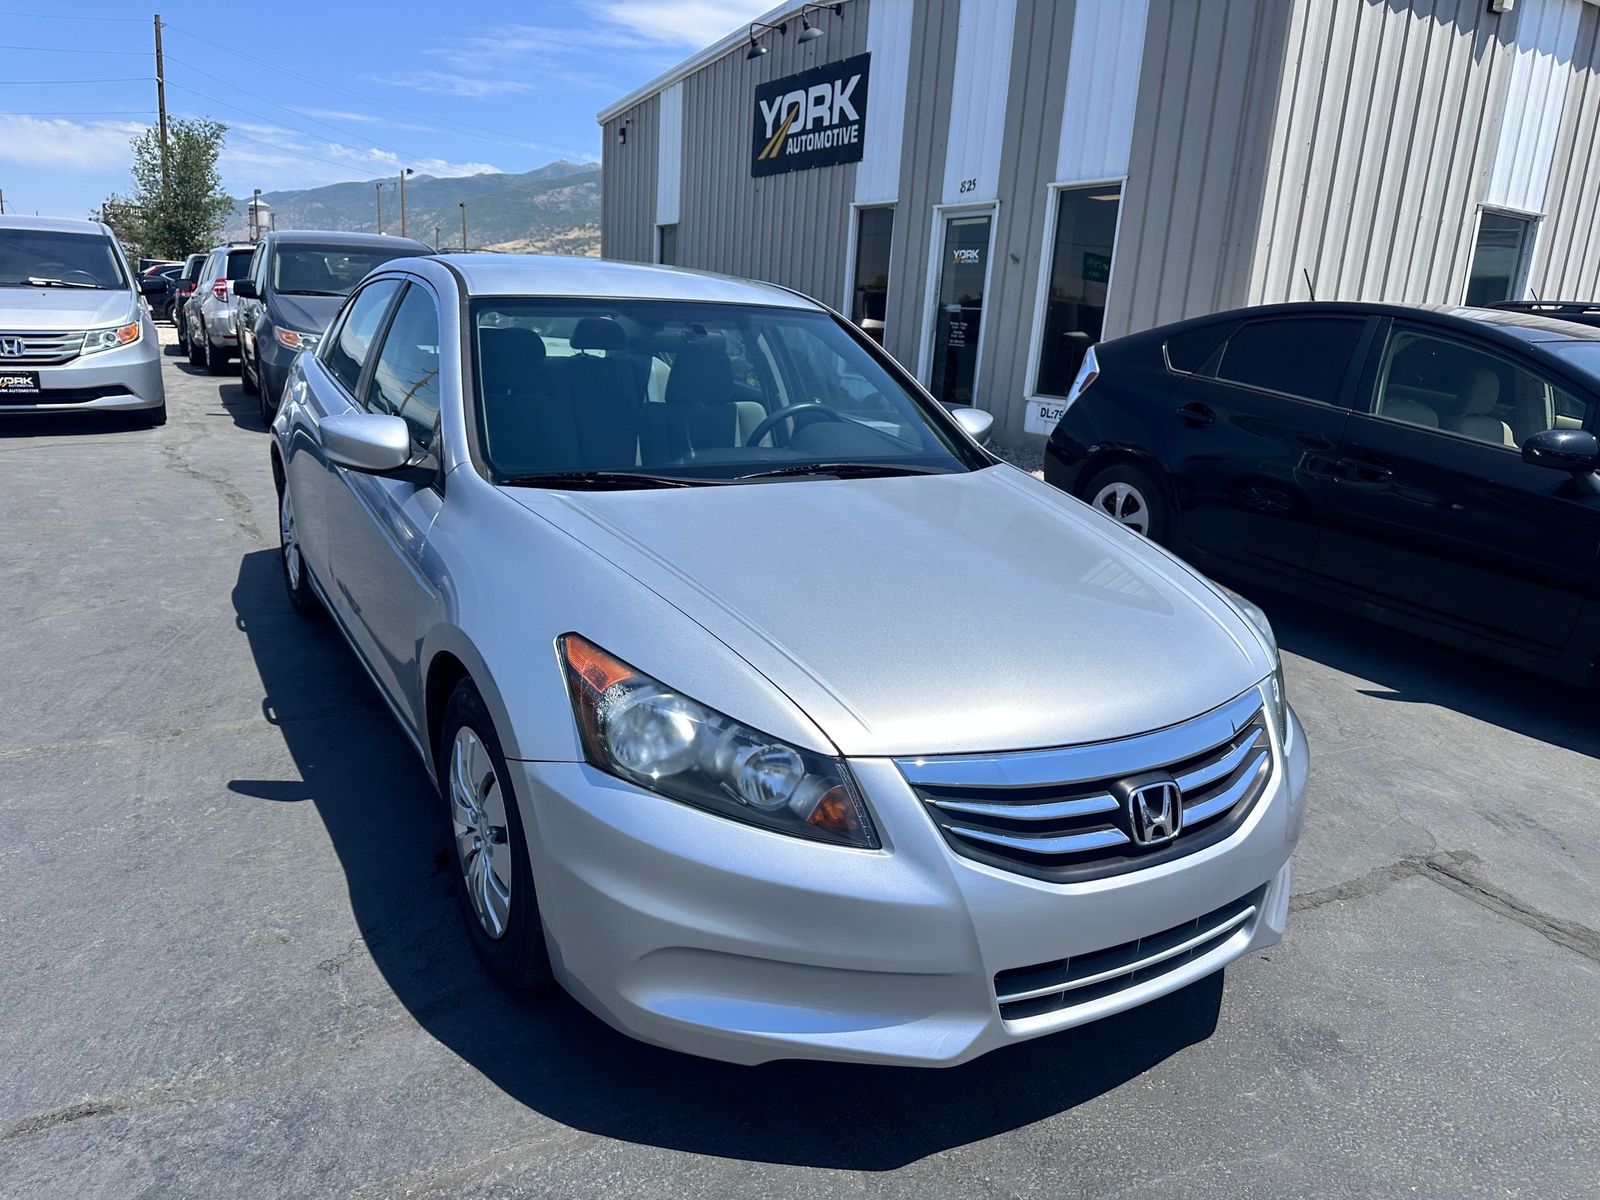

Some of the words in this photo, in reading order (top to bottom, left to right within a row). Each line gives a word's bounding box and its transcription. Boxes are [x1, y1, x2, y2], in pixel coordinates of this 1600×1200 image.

[759, 73, 862, 139] YORK
[786, 124, 859, 155] AUTOMOTIVE
[960, 178, 976, 193] 825
[953, 249, 979, 259] YORK
